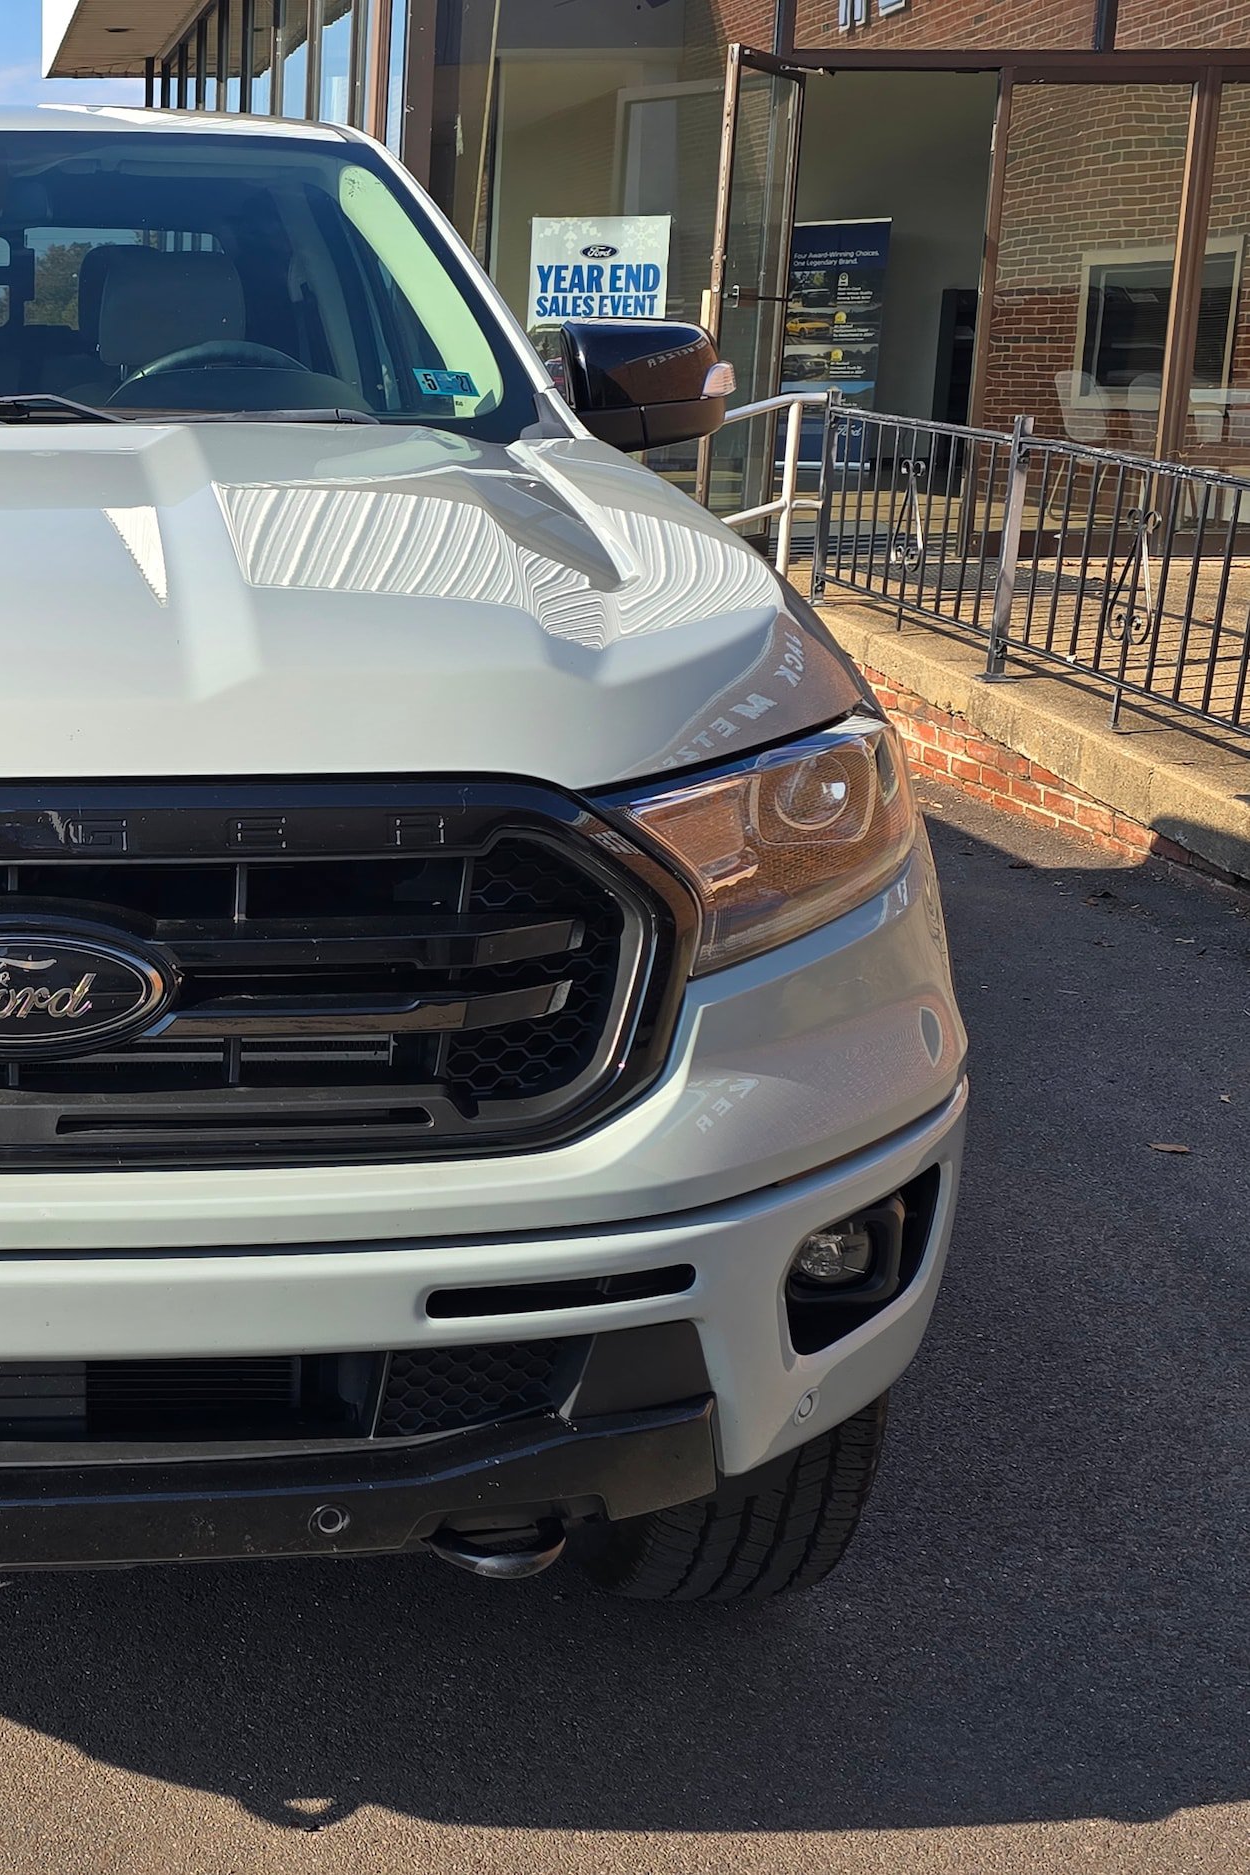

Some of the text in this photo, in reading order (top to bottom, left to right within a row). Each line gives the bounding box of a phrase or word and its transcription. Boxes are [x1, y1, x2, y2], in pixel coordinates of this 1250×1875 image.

[587, 245, 612, 258] Ford
[793, 252, 808, 260] Four
[808, 250, 854, 259] Award-Winning
[806, 258, 838, 267] Legendary
[536, 263, 661, 294] YEAR END
[535, 294, 658, 317] SALES EVENT
